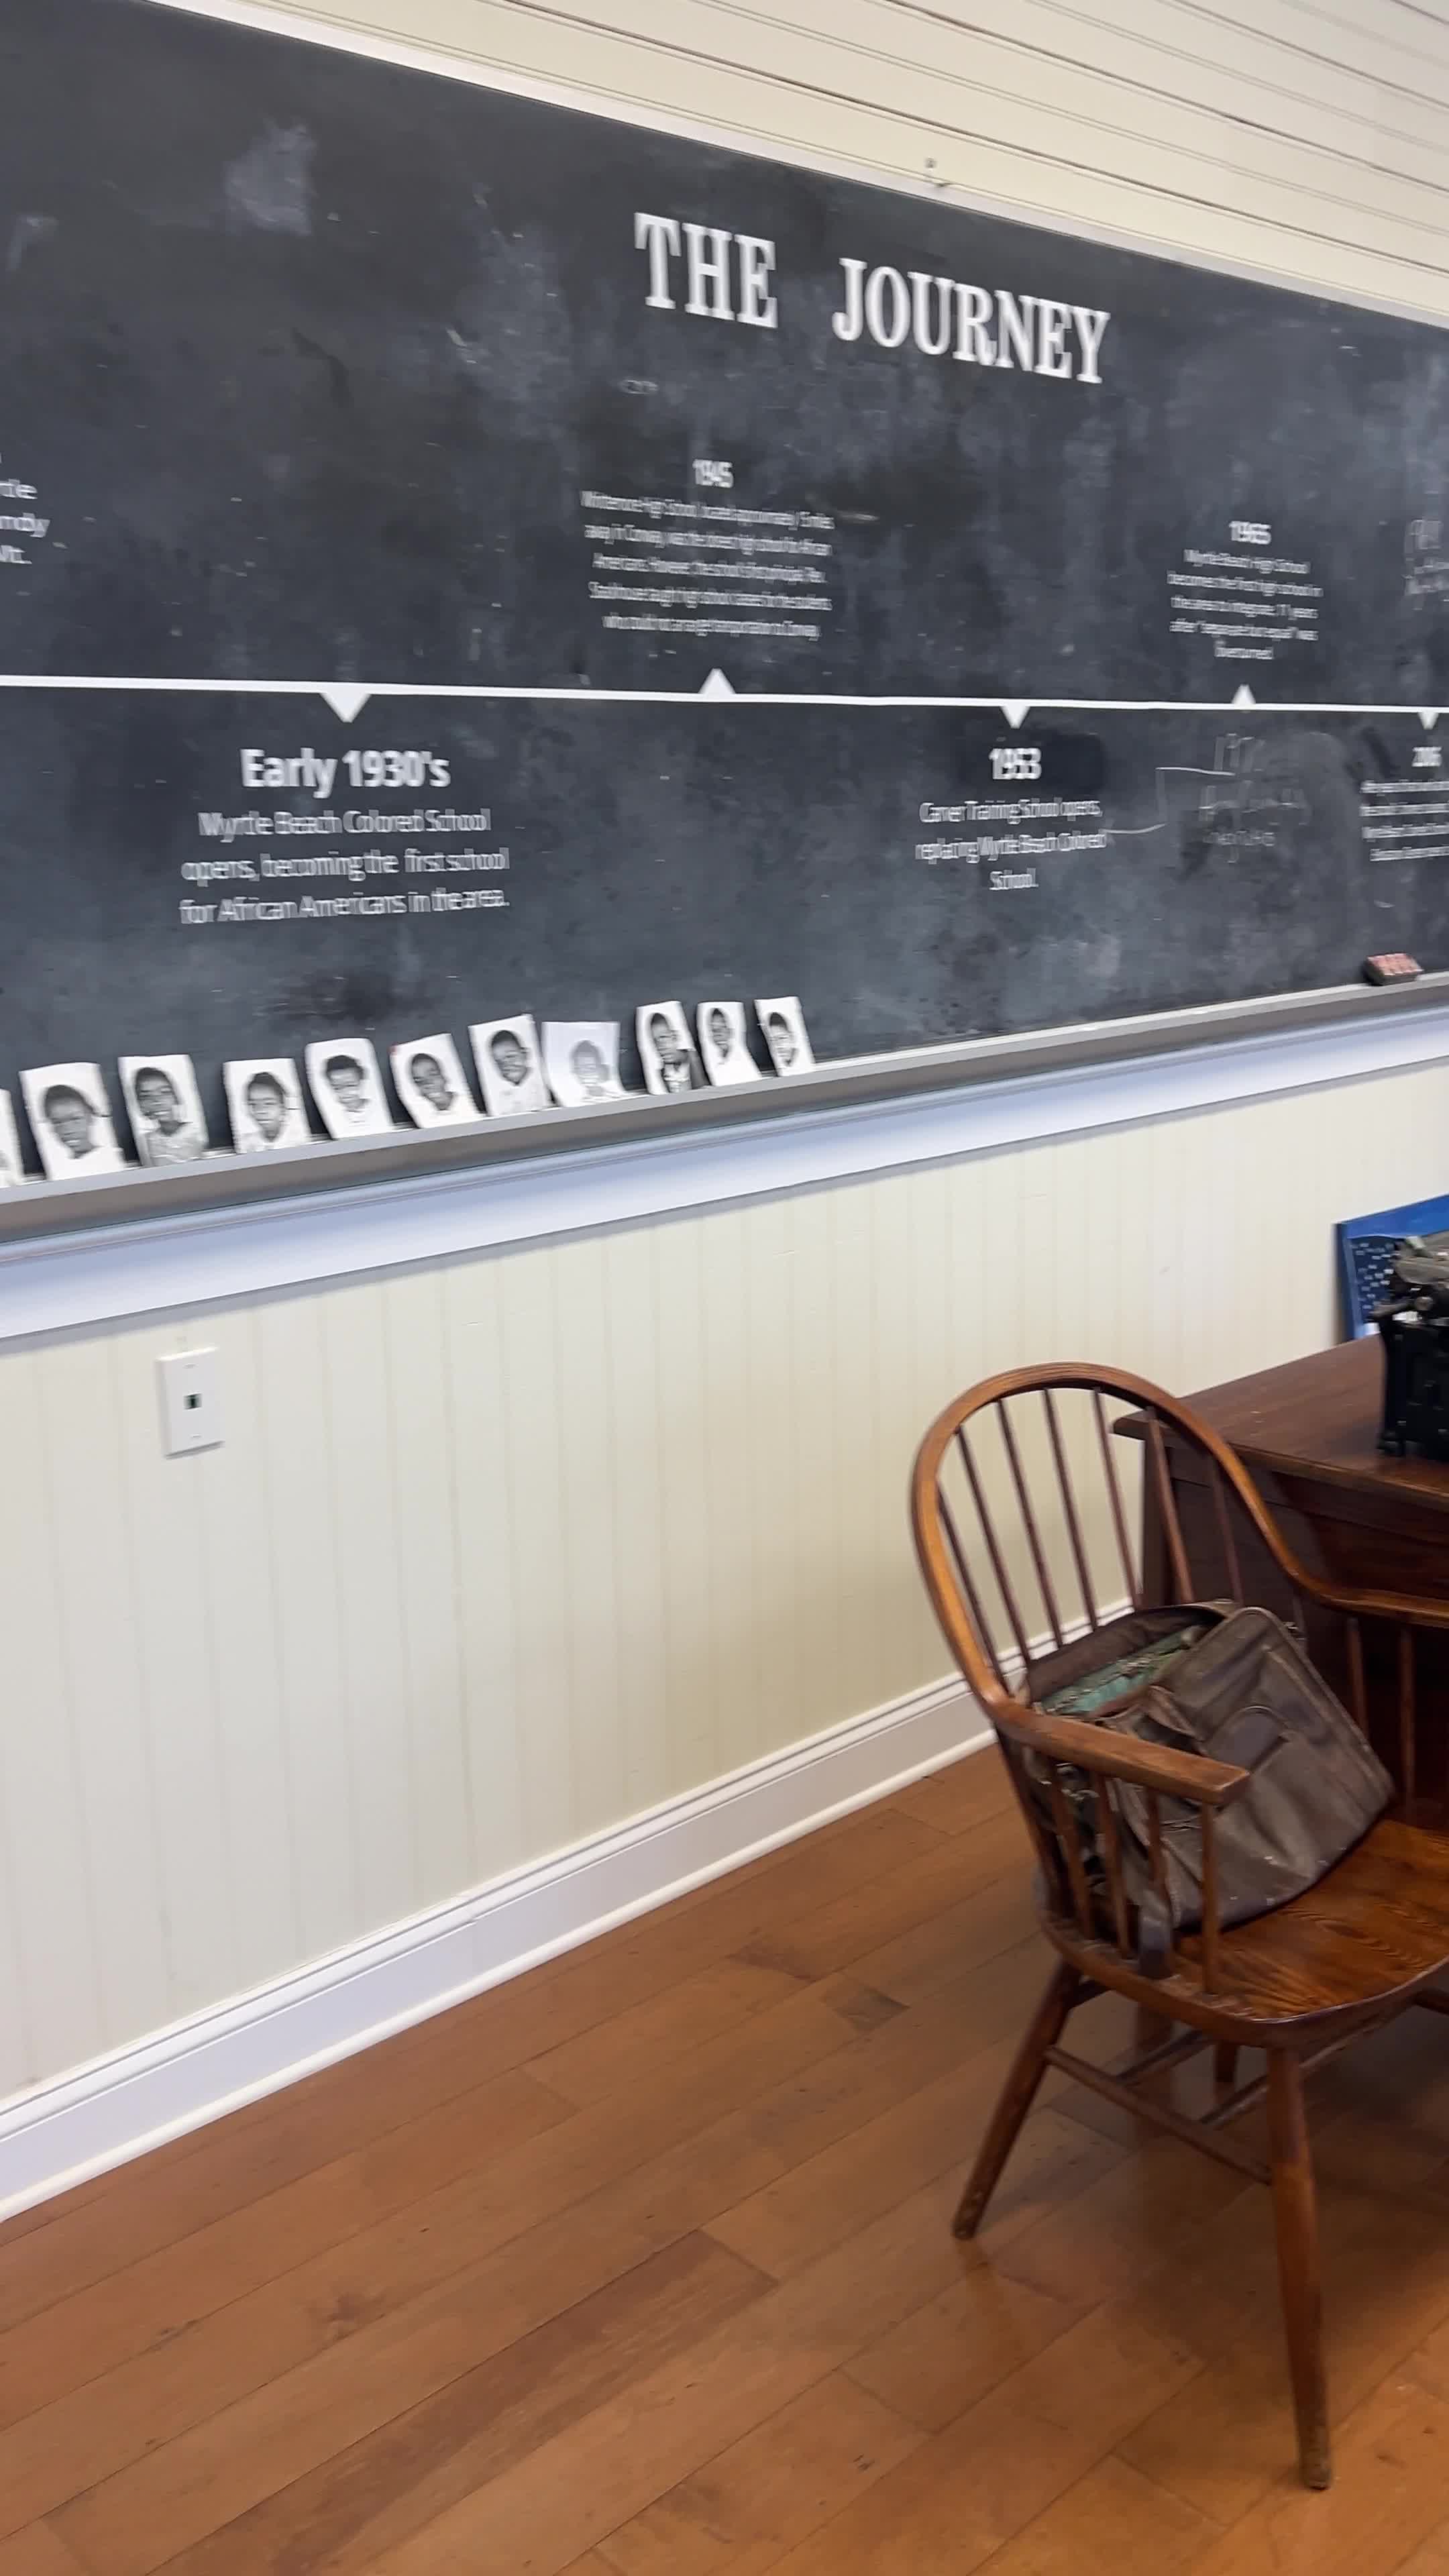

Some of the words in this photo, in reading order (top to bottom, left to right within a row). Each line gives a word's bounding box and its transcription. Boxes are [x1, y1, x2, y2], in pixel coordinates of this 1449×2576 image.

[635, 213, 778, 328] THE
[832, 258, 1111, 384] JOURNEY
[240, 748, 337, 798] Early
[342, 750, 451, 788] 1930's
[989, 748, 1041, 780] 1953
[199, 811, 273, 843] Myrtle
[274, 810, 341, 835] Beach
[343, 808, 424, 833] Colored
[425, 808, 490, 832] School
[181, 860, 260, 887] opens,
[260, 853, 366, 881] becoming
[364, 849, 398, 874] the
[405, 848, 445, 873] first
[445, 847, 510, 871] school
[179, 899, 217, 924] for
[218, 896, 297, 921] African
[301, 892, 407, 918] Americans
[407, 892, 430, 913] in
[430, 888, 463, 912] the
